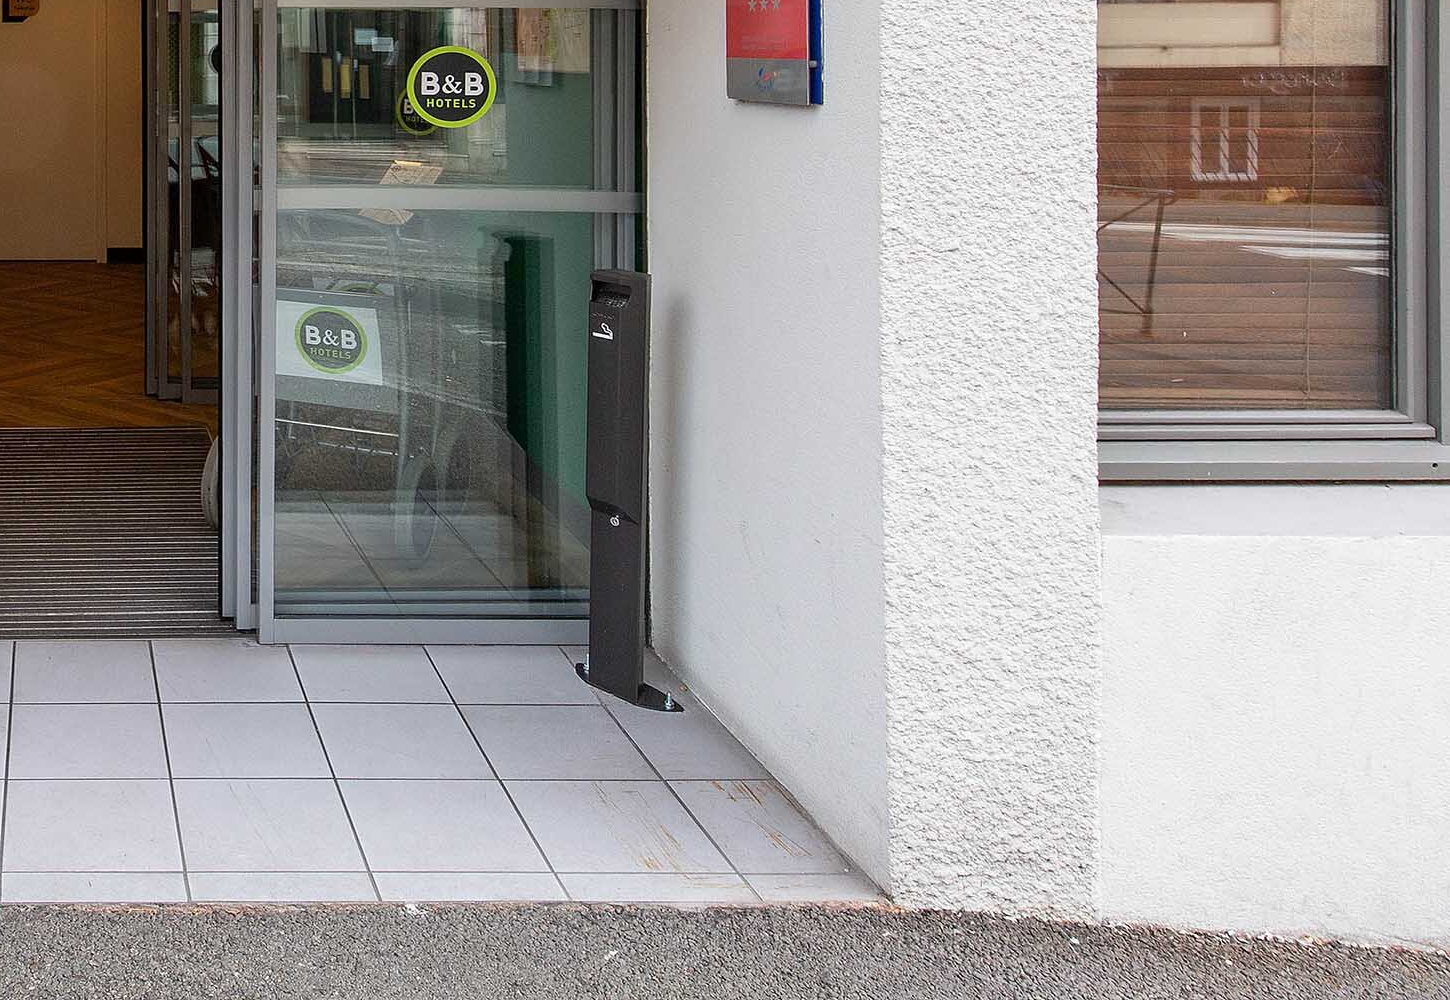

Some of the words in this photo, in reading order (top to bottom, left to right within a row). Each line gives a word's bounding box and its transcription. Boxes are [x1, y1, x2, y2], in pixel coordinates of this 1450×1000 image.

[421, 71, 484, 96] B&B
[426, 98, 476, 108] HOTELS
[305, 325, 357, 349] B&B
[310, 347, 351, 359] HOTELS
